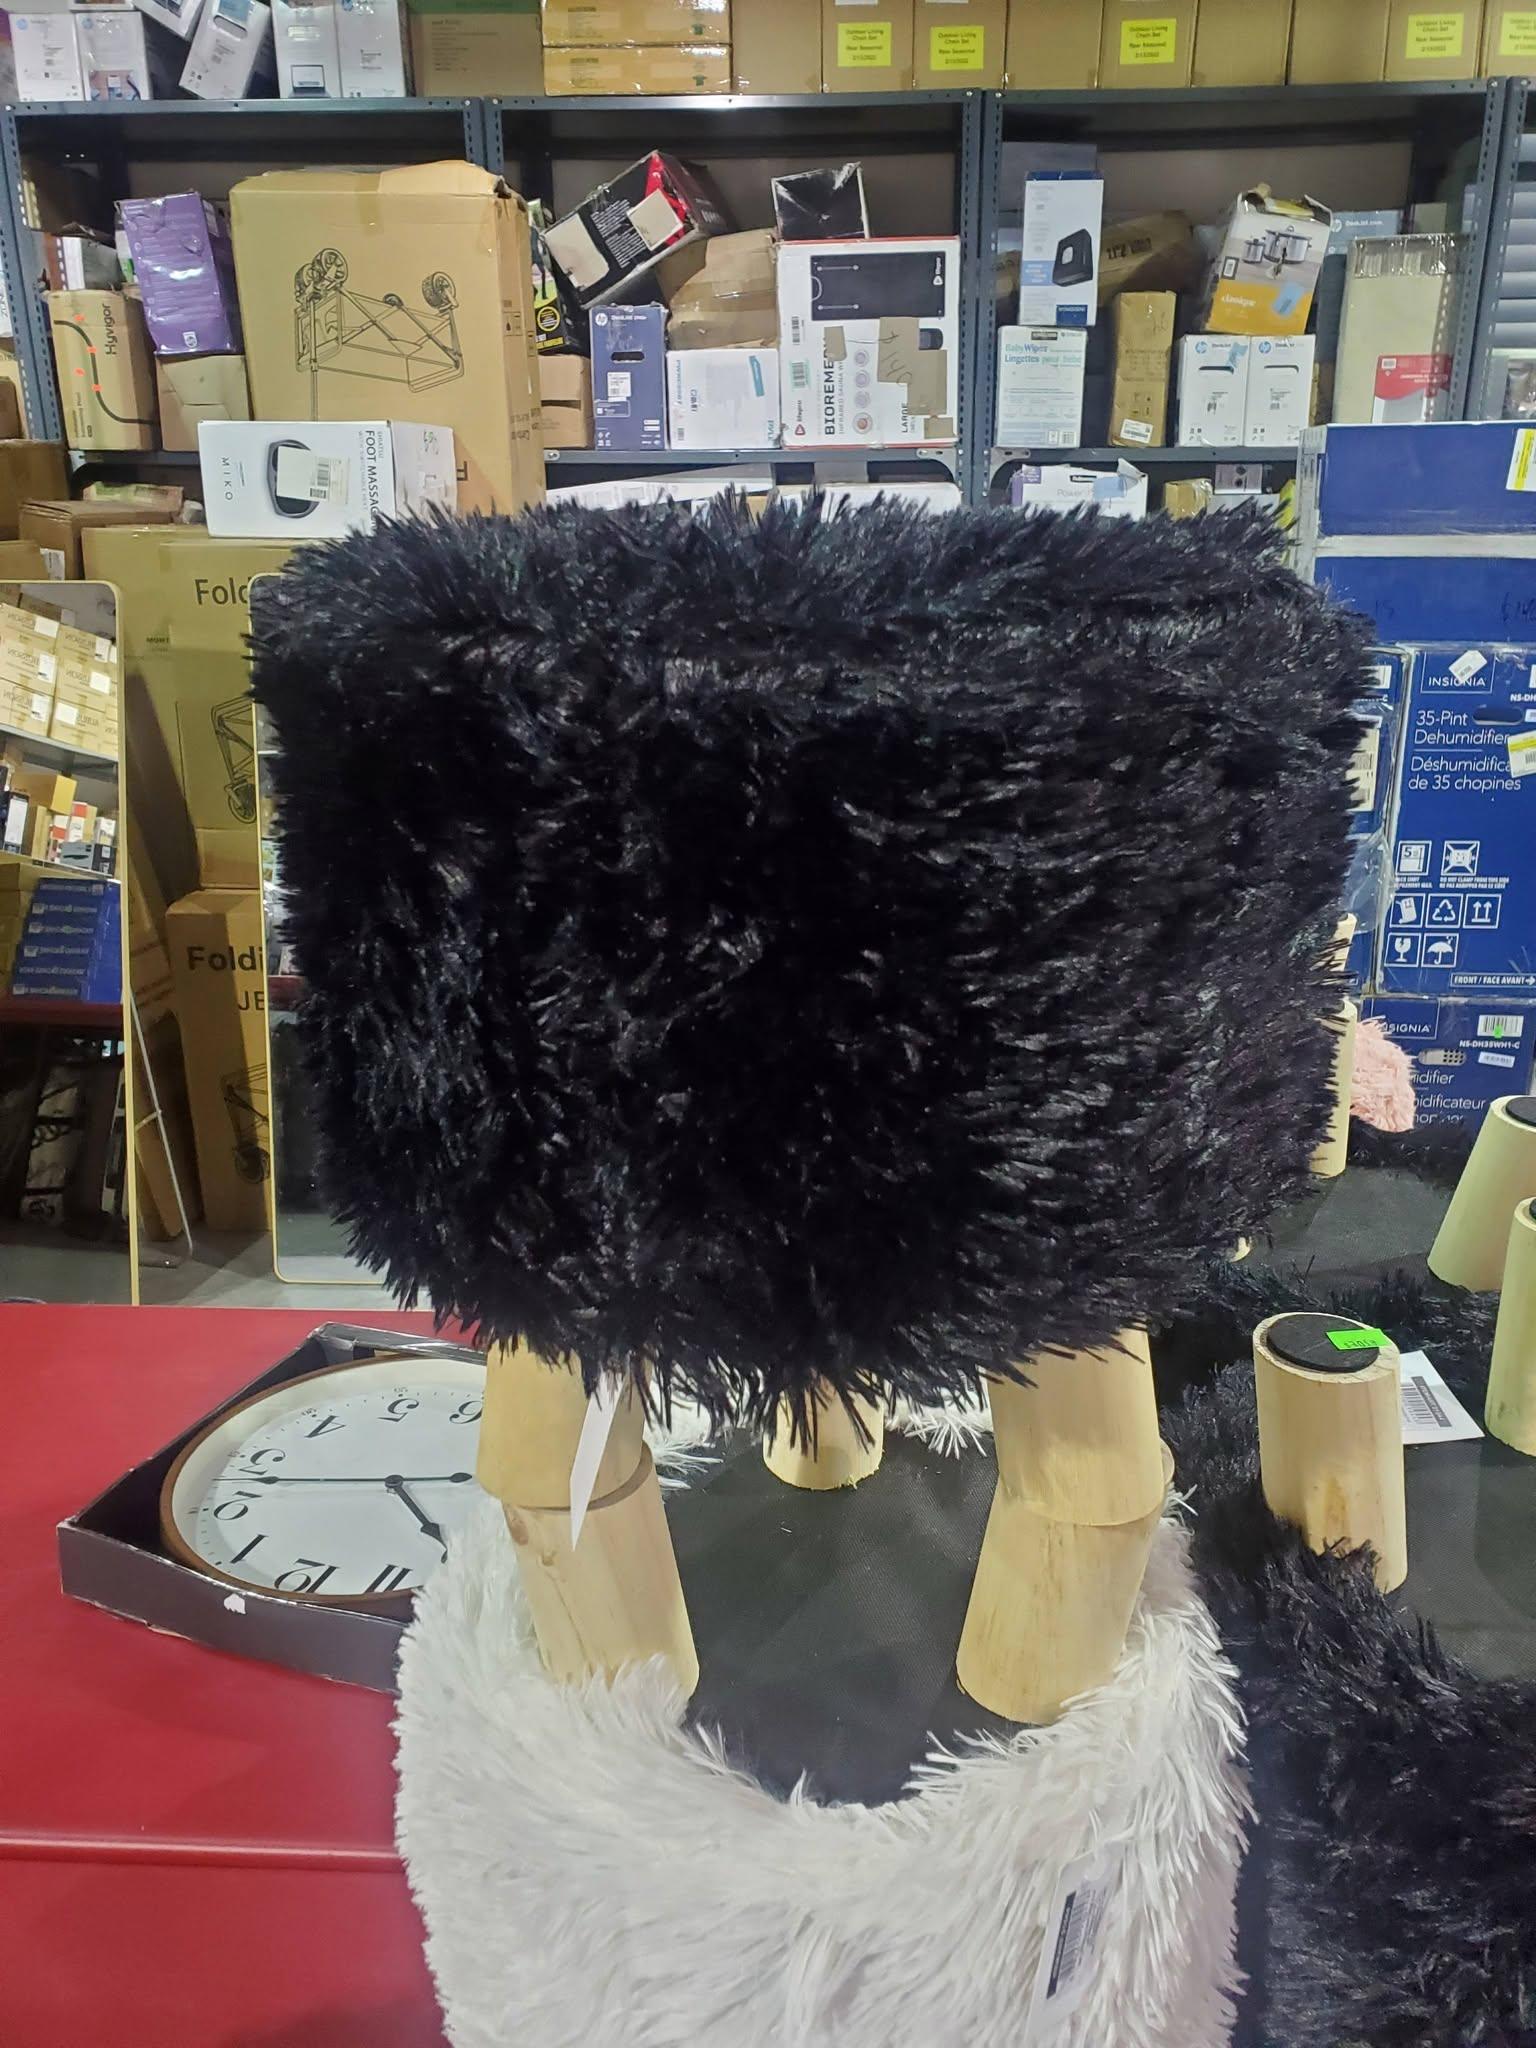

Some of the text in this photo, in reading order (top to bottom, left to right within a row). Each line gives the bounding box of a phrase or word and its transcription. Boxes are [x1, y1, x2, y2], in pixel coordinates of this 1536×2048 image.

[102, 303, 118, 355] Hyvigor
[823, 338, 835, 435] BIOREME
[221, 456, 234, 501] MIKO
[365, 430, 380, 525] FOOT MASSAG
[1415, 710, 1468, 728] 35-Pint
[1414, 728, 1510, 746] Dehumidifier
[1411, 755, 1511, 772] Déshumidifica
[1408, 775, 1522, 794] de 35 chopines
[1454, 976, 1477, 985] FRONT
[1482, 976, 1500, 985] FACE
[1500, 976, 1526, 985] AVANT
[1388, 1024, 1430, 1033] SIGNIA
[1413, 1069, 1455, 1085] idifier
[378, 1398, 420, 1422] 5
[449, 1400, 484, 1424] 6
[304, 1415, 347, 1438] 4
[239, 1448, 286, 1476] 3
[213, 1490, 263, 1521] 2
[230, 1534, 269, 1564] 1
[273, 1558, 341, 1594] 12
[365, 1564, 413, 1594] 11
